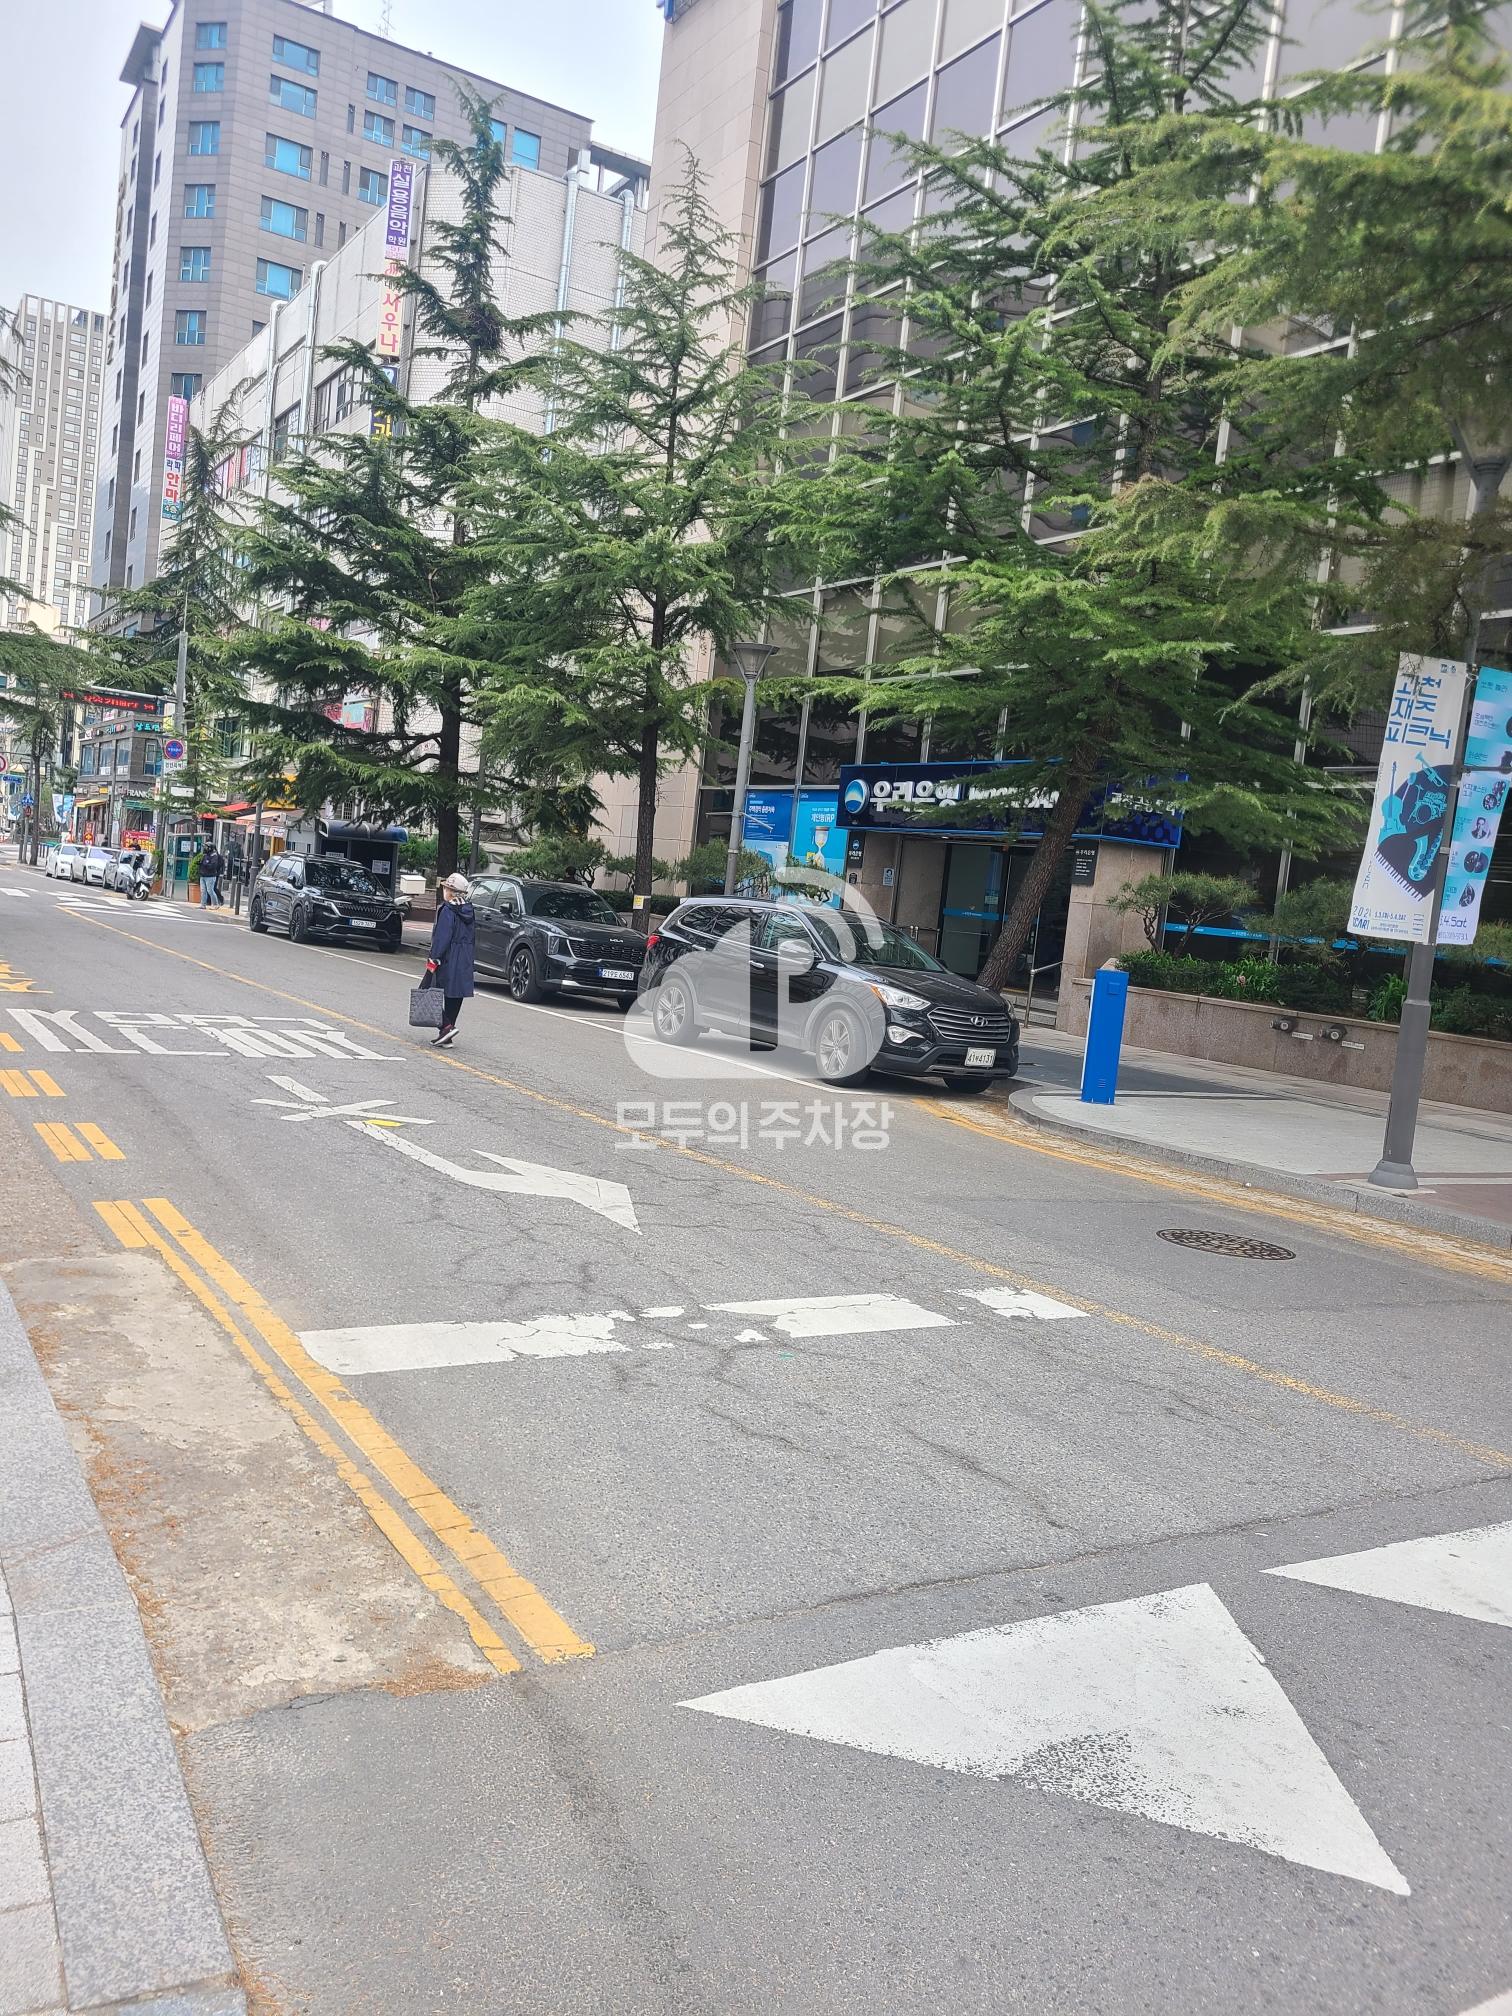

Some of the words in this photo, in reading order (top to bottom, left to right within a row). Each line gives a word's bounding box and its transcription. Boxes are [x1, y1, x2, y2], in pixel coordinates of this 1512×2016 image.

[389, 174, 410, 235] 실용음악
[380, 293, 401, 353] 사우나
[168, 403, 185, 453] 바디리페어
[165, 472, 180, 504] 안마
[1396, 672, 1442, 699] 과천
[1391, 697, 1437, 723] 재즈
[1385, 721, 1452, 749] 피크닉
[869, 780, 962, 813] 우리은행
